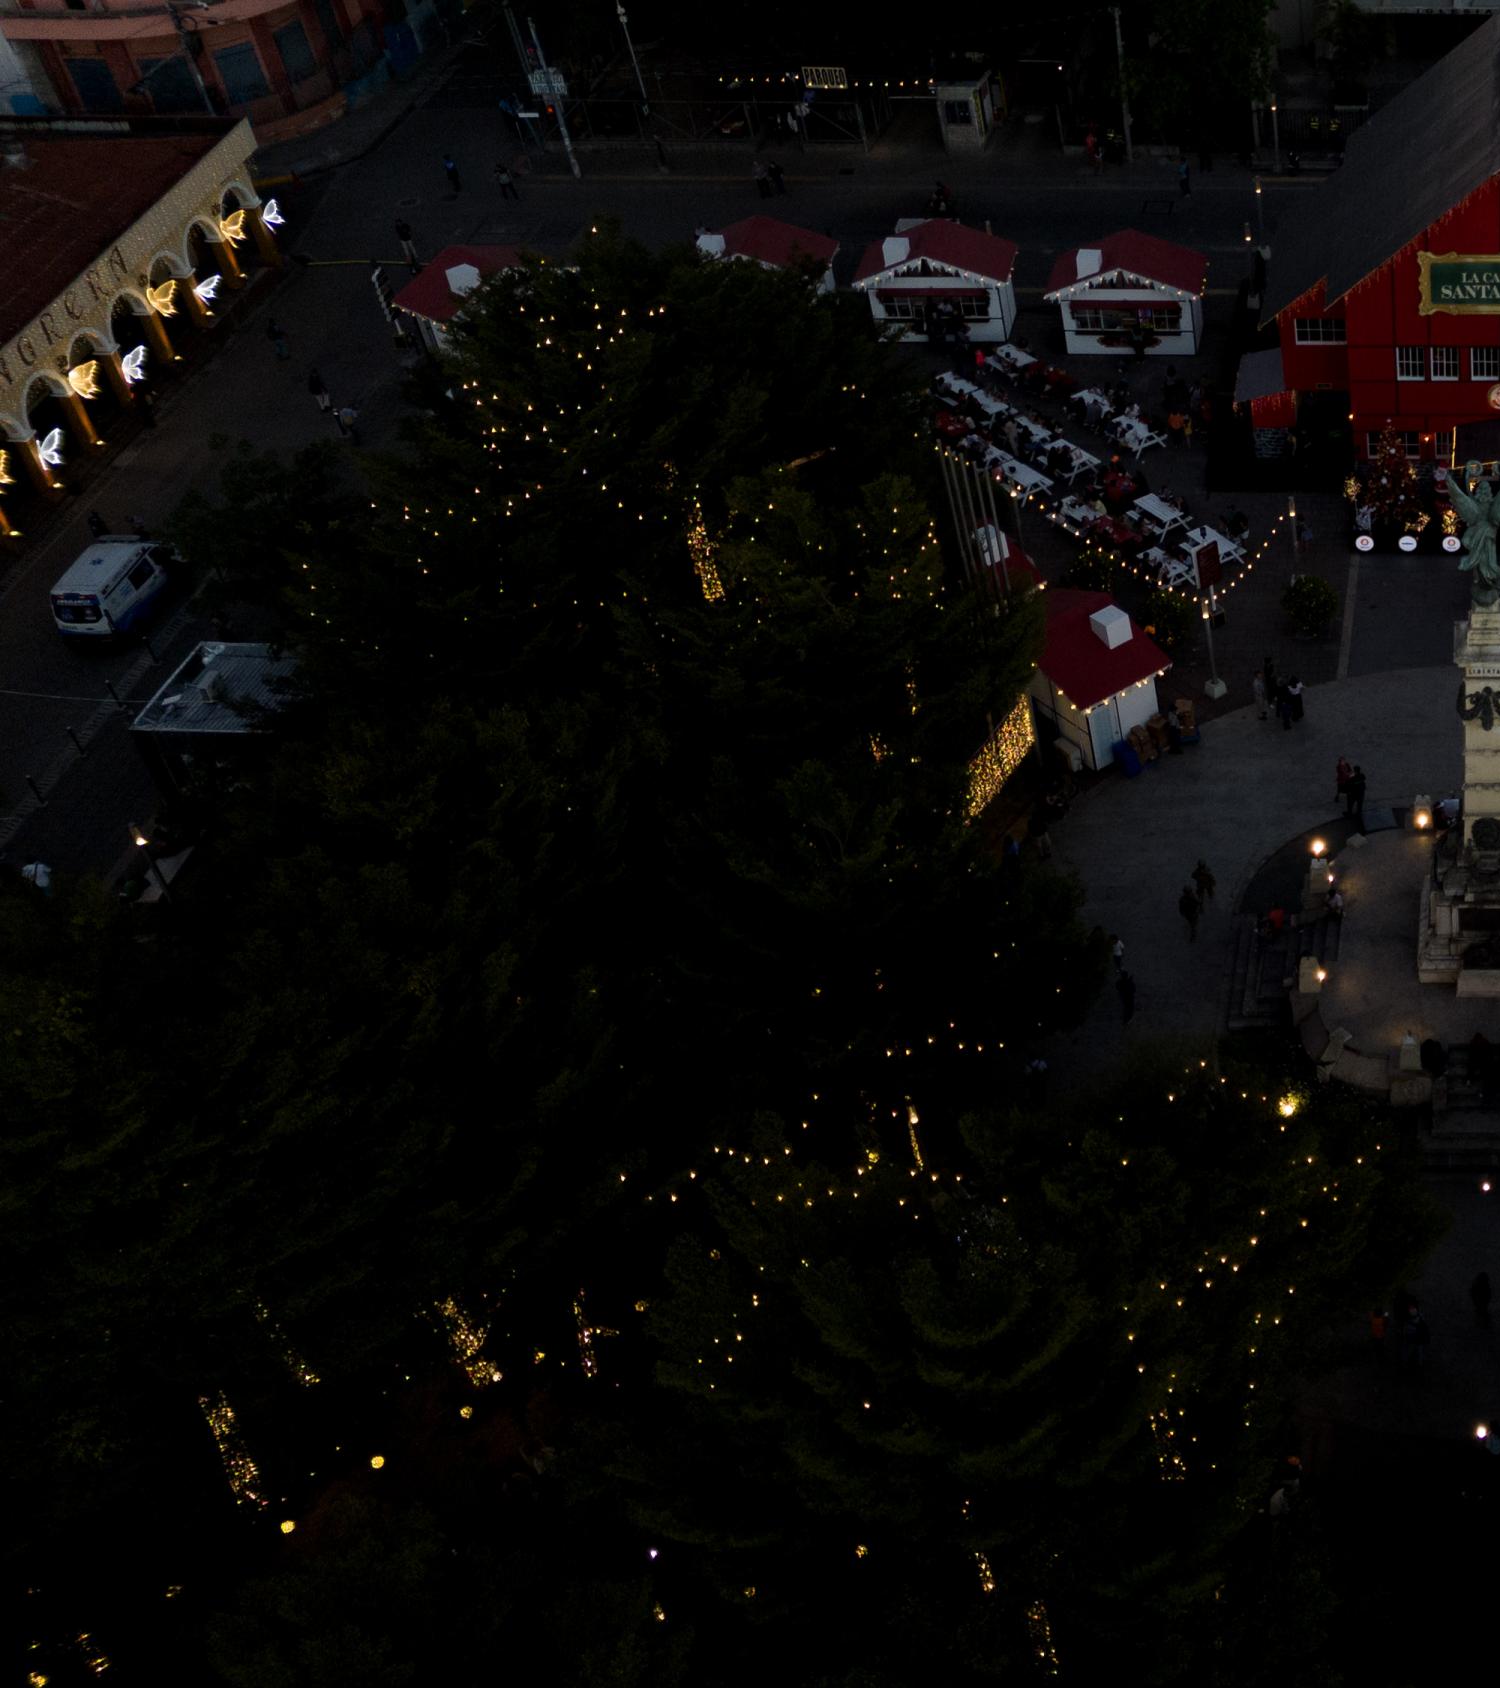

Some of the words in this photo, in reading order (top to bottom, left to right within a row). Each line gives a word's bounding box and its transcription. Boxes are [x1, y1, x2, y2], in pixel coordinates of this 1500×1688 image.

[803, 67, 847, 87] PARQUEO
[1461, 272, 1480, 283] LA
[1440, 284, 1500, 299] SANTA
